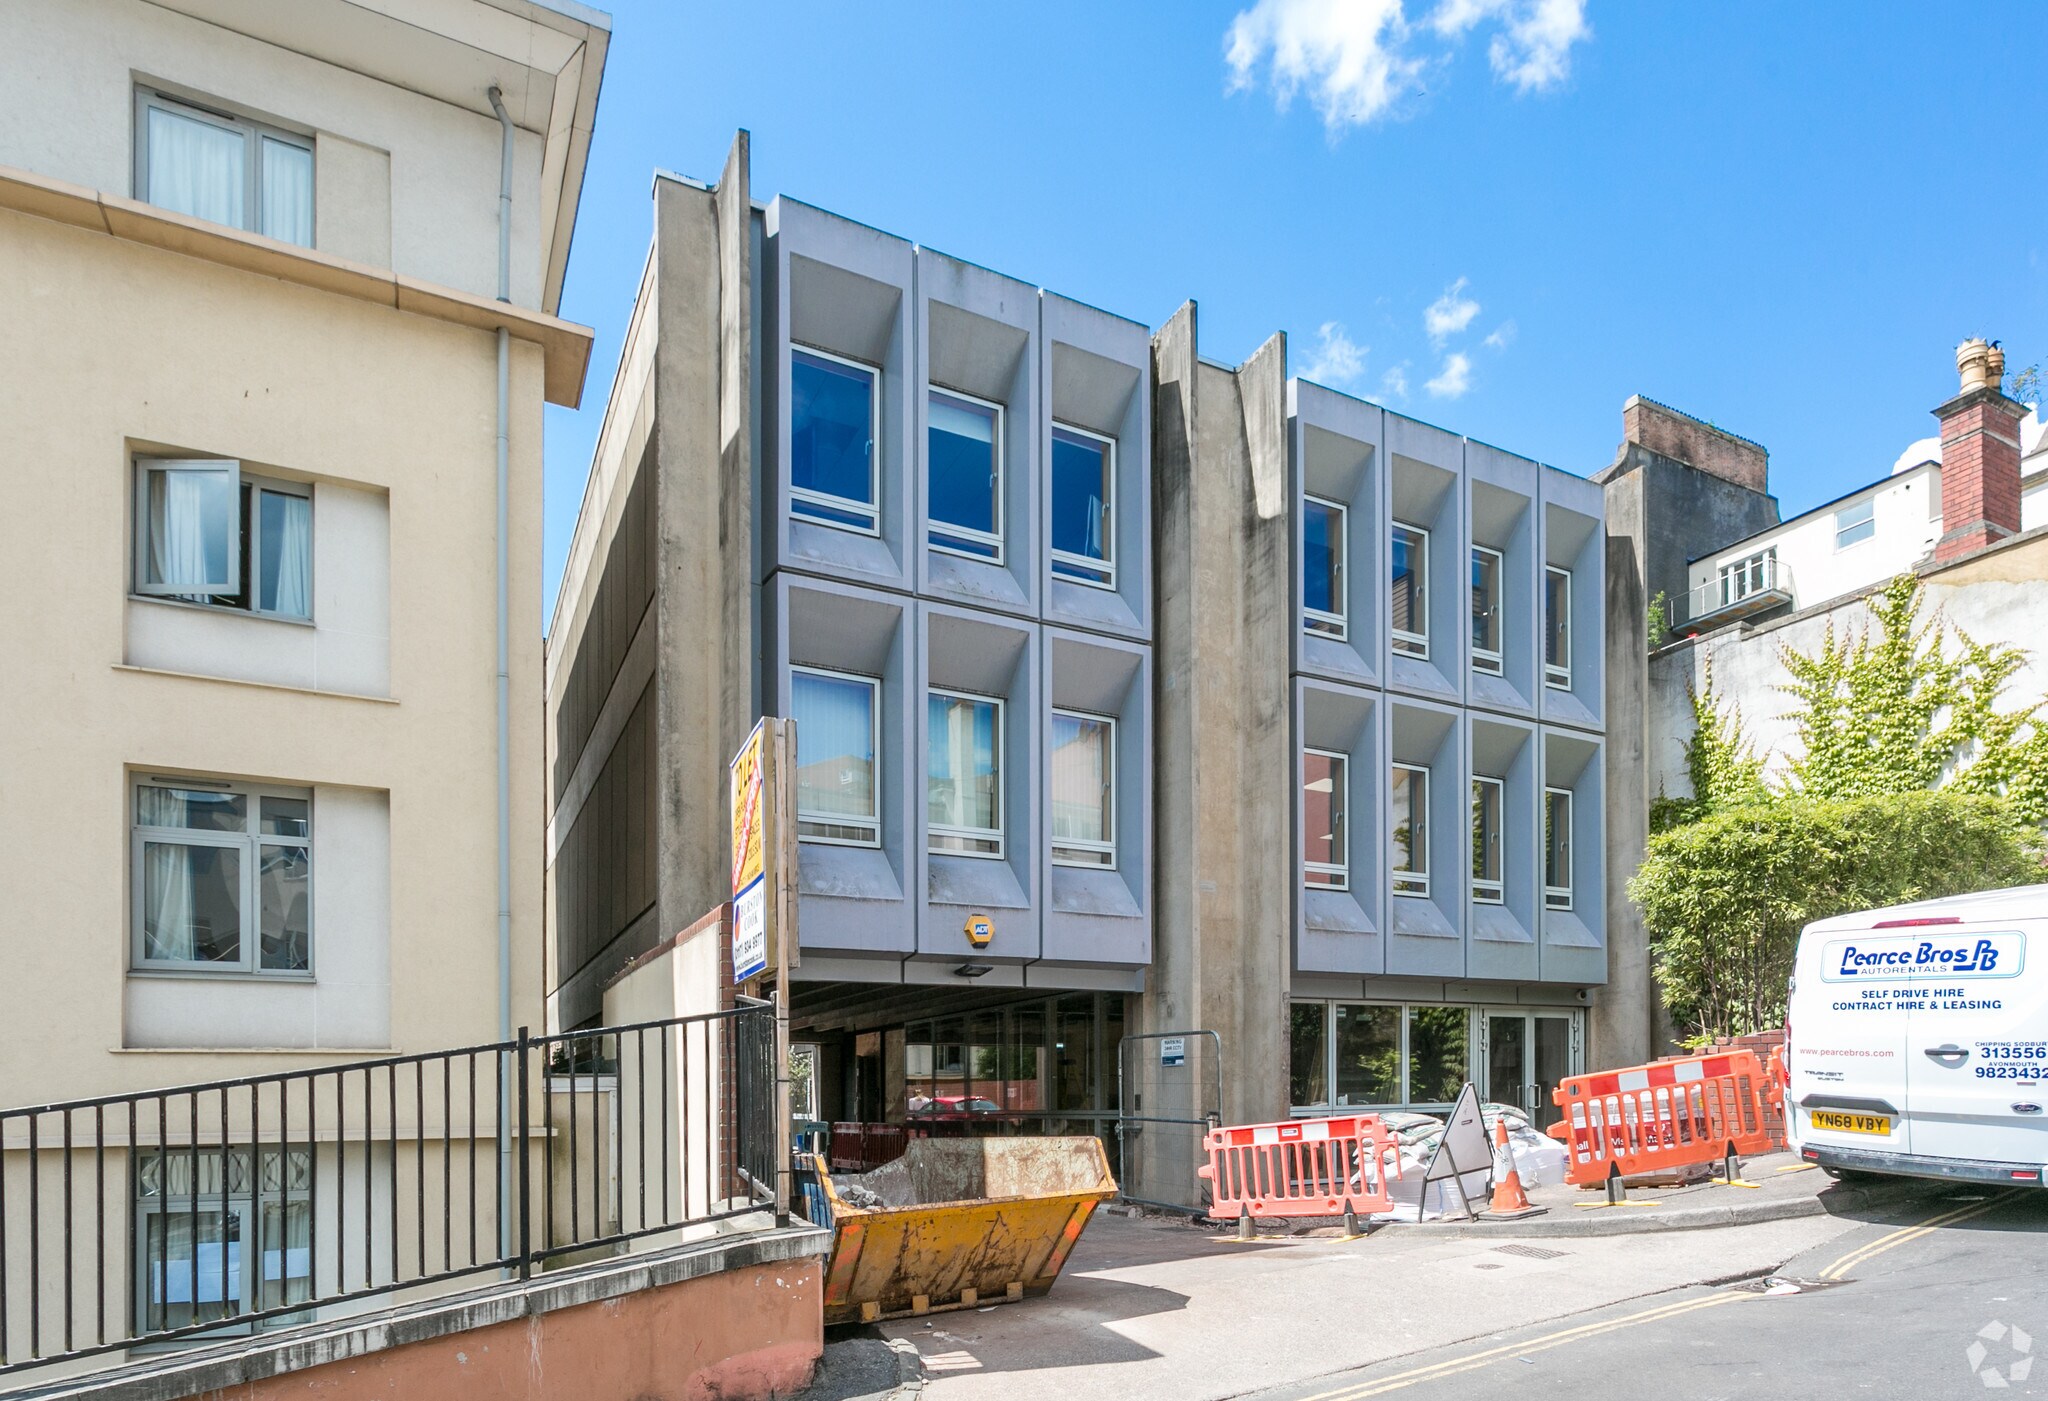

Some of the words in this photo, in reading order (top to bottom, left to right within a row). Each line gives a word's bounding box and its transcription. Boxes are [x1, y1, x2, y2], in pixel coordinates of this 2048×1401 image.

[1841, 946, 1913, 968] Pearce
[1915, 942, 1968, 965] Bros
[1860, 965, 1948, 975] AUTORENTALS
[1861, 990, 1889, 999] SELF
[1893, 989, 1929, 998] DRIVE
[1933, 988, 1965, 997] HIRE
[1832, 1001, 1893, 1011] CONTRACT
[1896, 1001, 1925, 1010] HIRE
[1929, 1000, 1938, 1010] &
[1943, 1000, 2002, 1009] LEASING
[1799, 1048, 1894, 1057] www.pearcebros.com
[1981, 1047, 2047, 1059] 313556
[1975, 1067, 2048, 1079] 9823432
[1816, 1113, 1852, 1128] YN68
[1856, 1116, 1884, 1131] VBY
